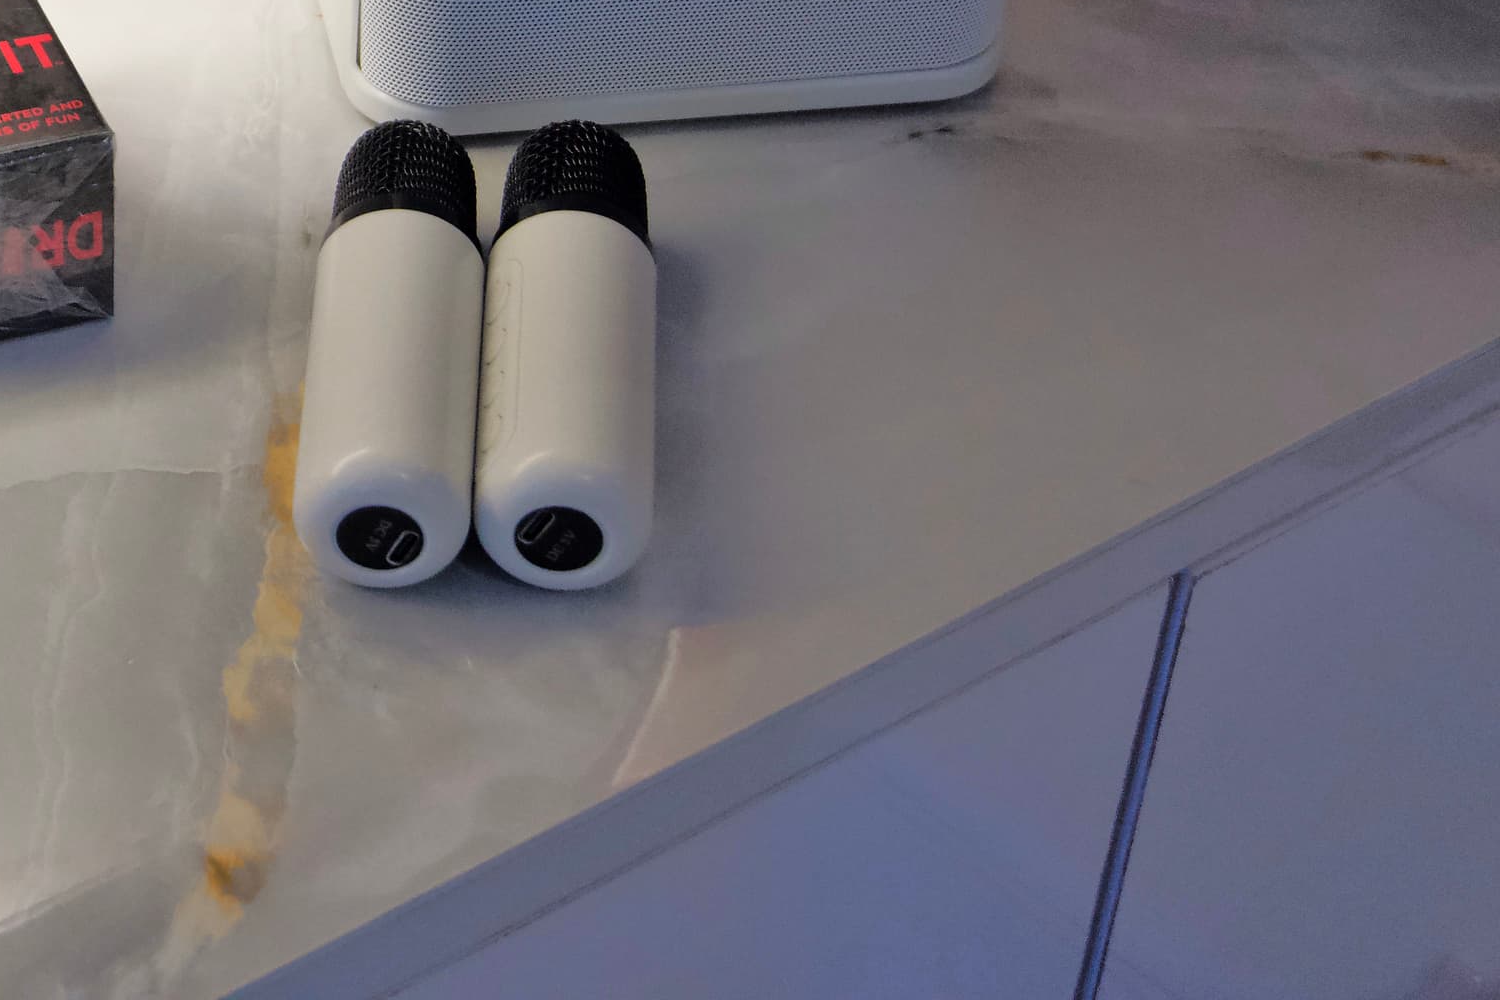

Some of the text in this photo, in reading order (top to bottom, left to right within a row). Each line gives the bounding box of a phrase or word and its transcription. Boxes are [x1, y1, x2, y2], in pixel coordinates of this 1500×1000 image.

[0, 33, 53, 75] IT
[49, 99, 84, 113] AND
[21, 120, 43, 133] OF
[45, 112, 81, 127] FUN
